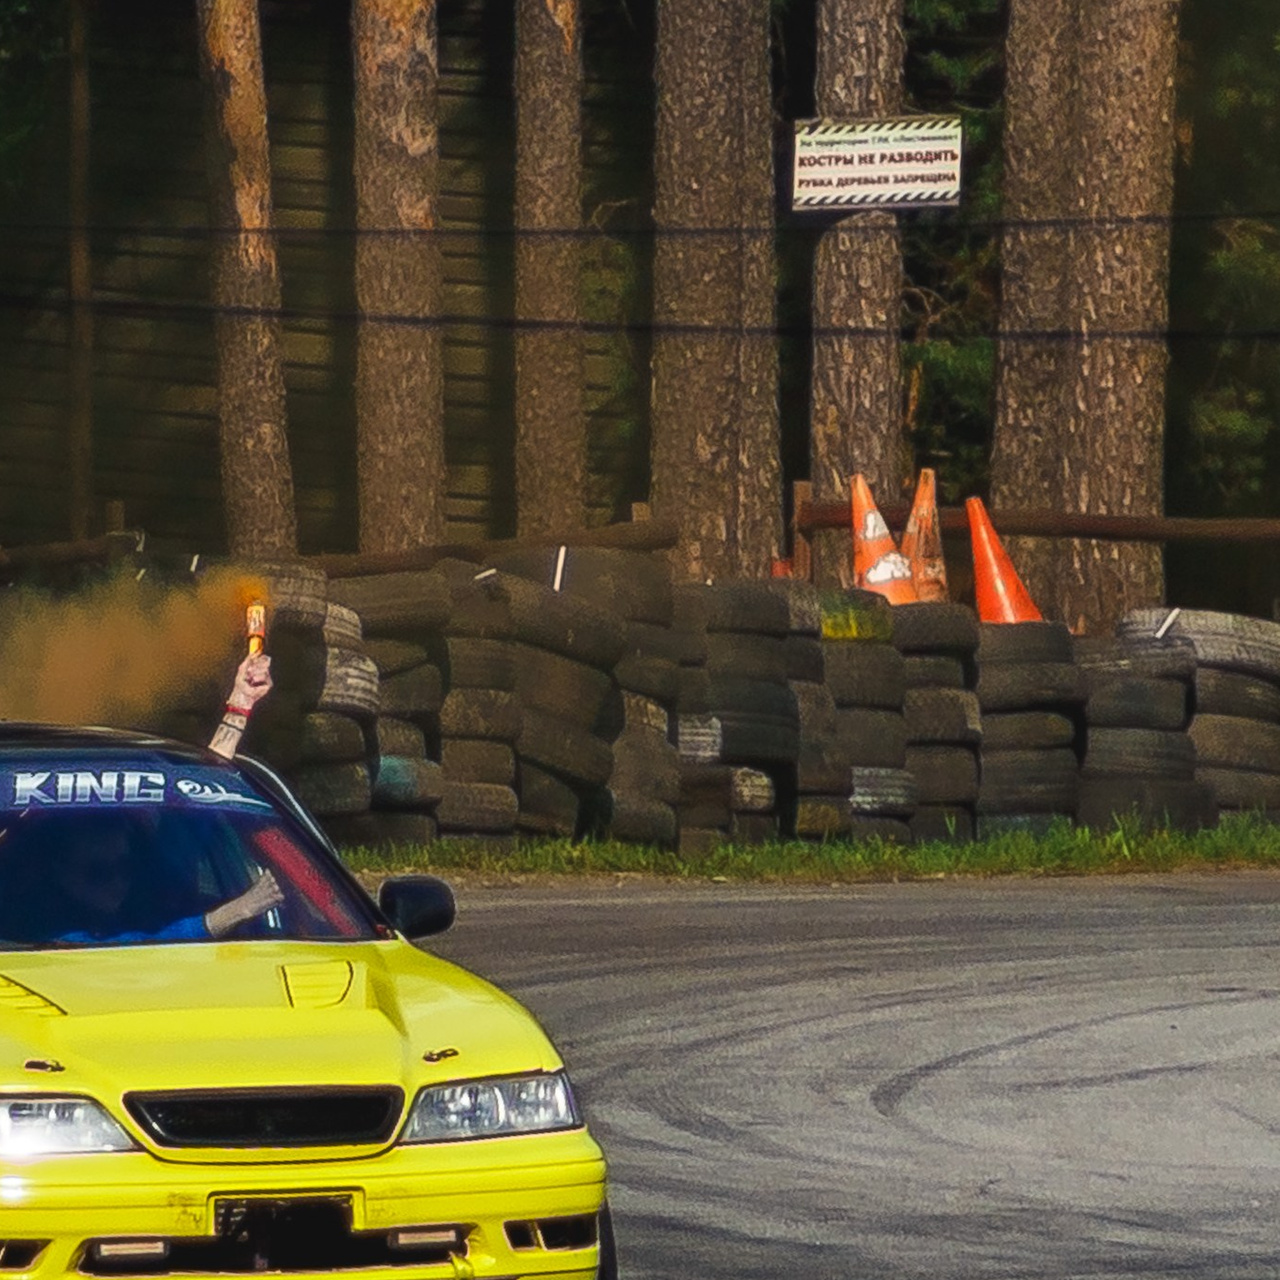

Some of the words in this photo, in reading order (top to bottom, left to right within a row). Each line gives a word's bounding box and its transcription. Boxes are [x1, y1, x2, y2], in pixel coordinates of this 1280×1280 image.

[798, 153, 854, 168] КОСТРЫ
[858, 152, 876, 166] НЕ
[880, 149, 959, 165] РАЗВОДИТЬ
[798, 177, 833, 189] РУБКА
[836, 175, 889, 188] ДЕРЕВЬЕВ
[893, 171, 957, 185] ЗАПРЕЩЕНА
[13, 771, 167, 805] KING
